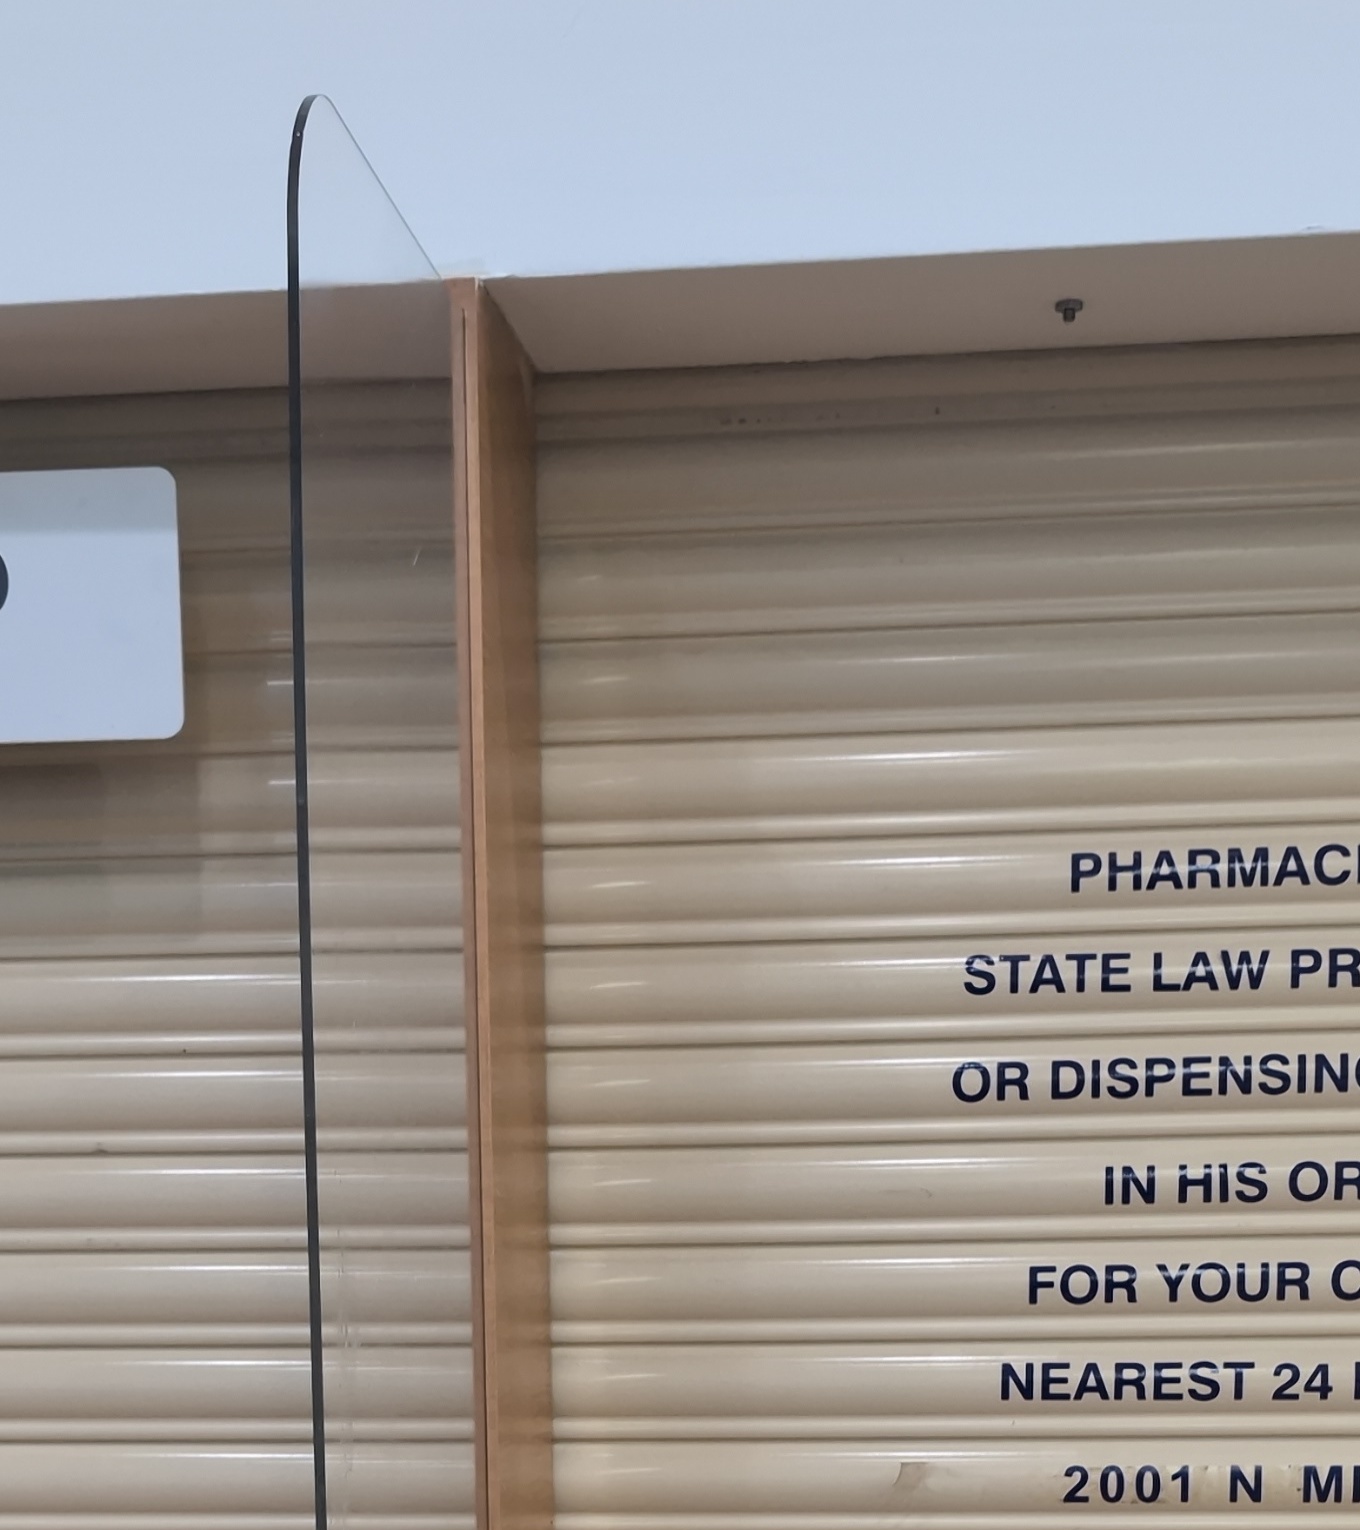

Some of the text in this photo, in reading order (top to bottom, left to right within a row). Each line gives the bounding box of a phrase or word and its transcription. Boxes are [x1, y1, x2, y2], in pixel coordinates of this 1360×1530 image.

[963, 952, 1132, 996] STATE
[1152, 950, 1270, 992] LAW
[952, 1061, 1030, 1103] OR
[1104, 1165, 1156, 1206] IN
[1177, 1161, 1268, 1204] HIS
[1028, 1264, 1138, 1306] FOR
[1156, 1261, 1310, 1304] YOUR
[1000, 1361, 1255, 1402] NEAREST
[1271, 1362, 1334, 1401] 24
[1062, 1465, 1189, 1504] 2001
[1229, 1466, 1262, 1503] N
